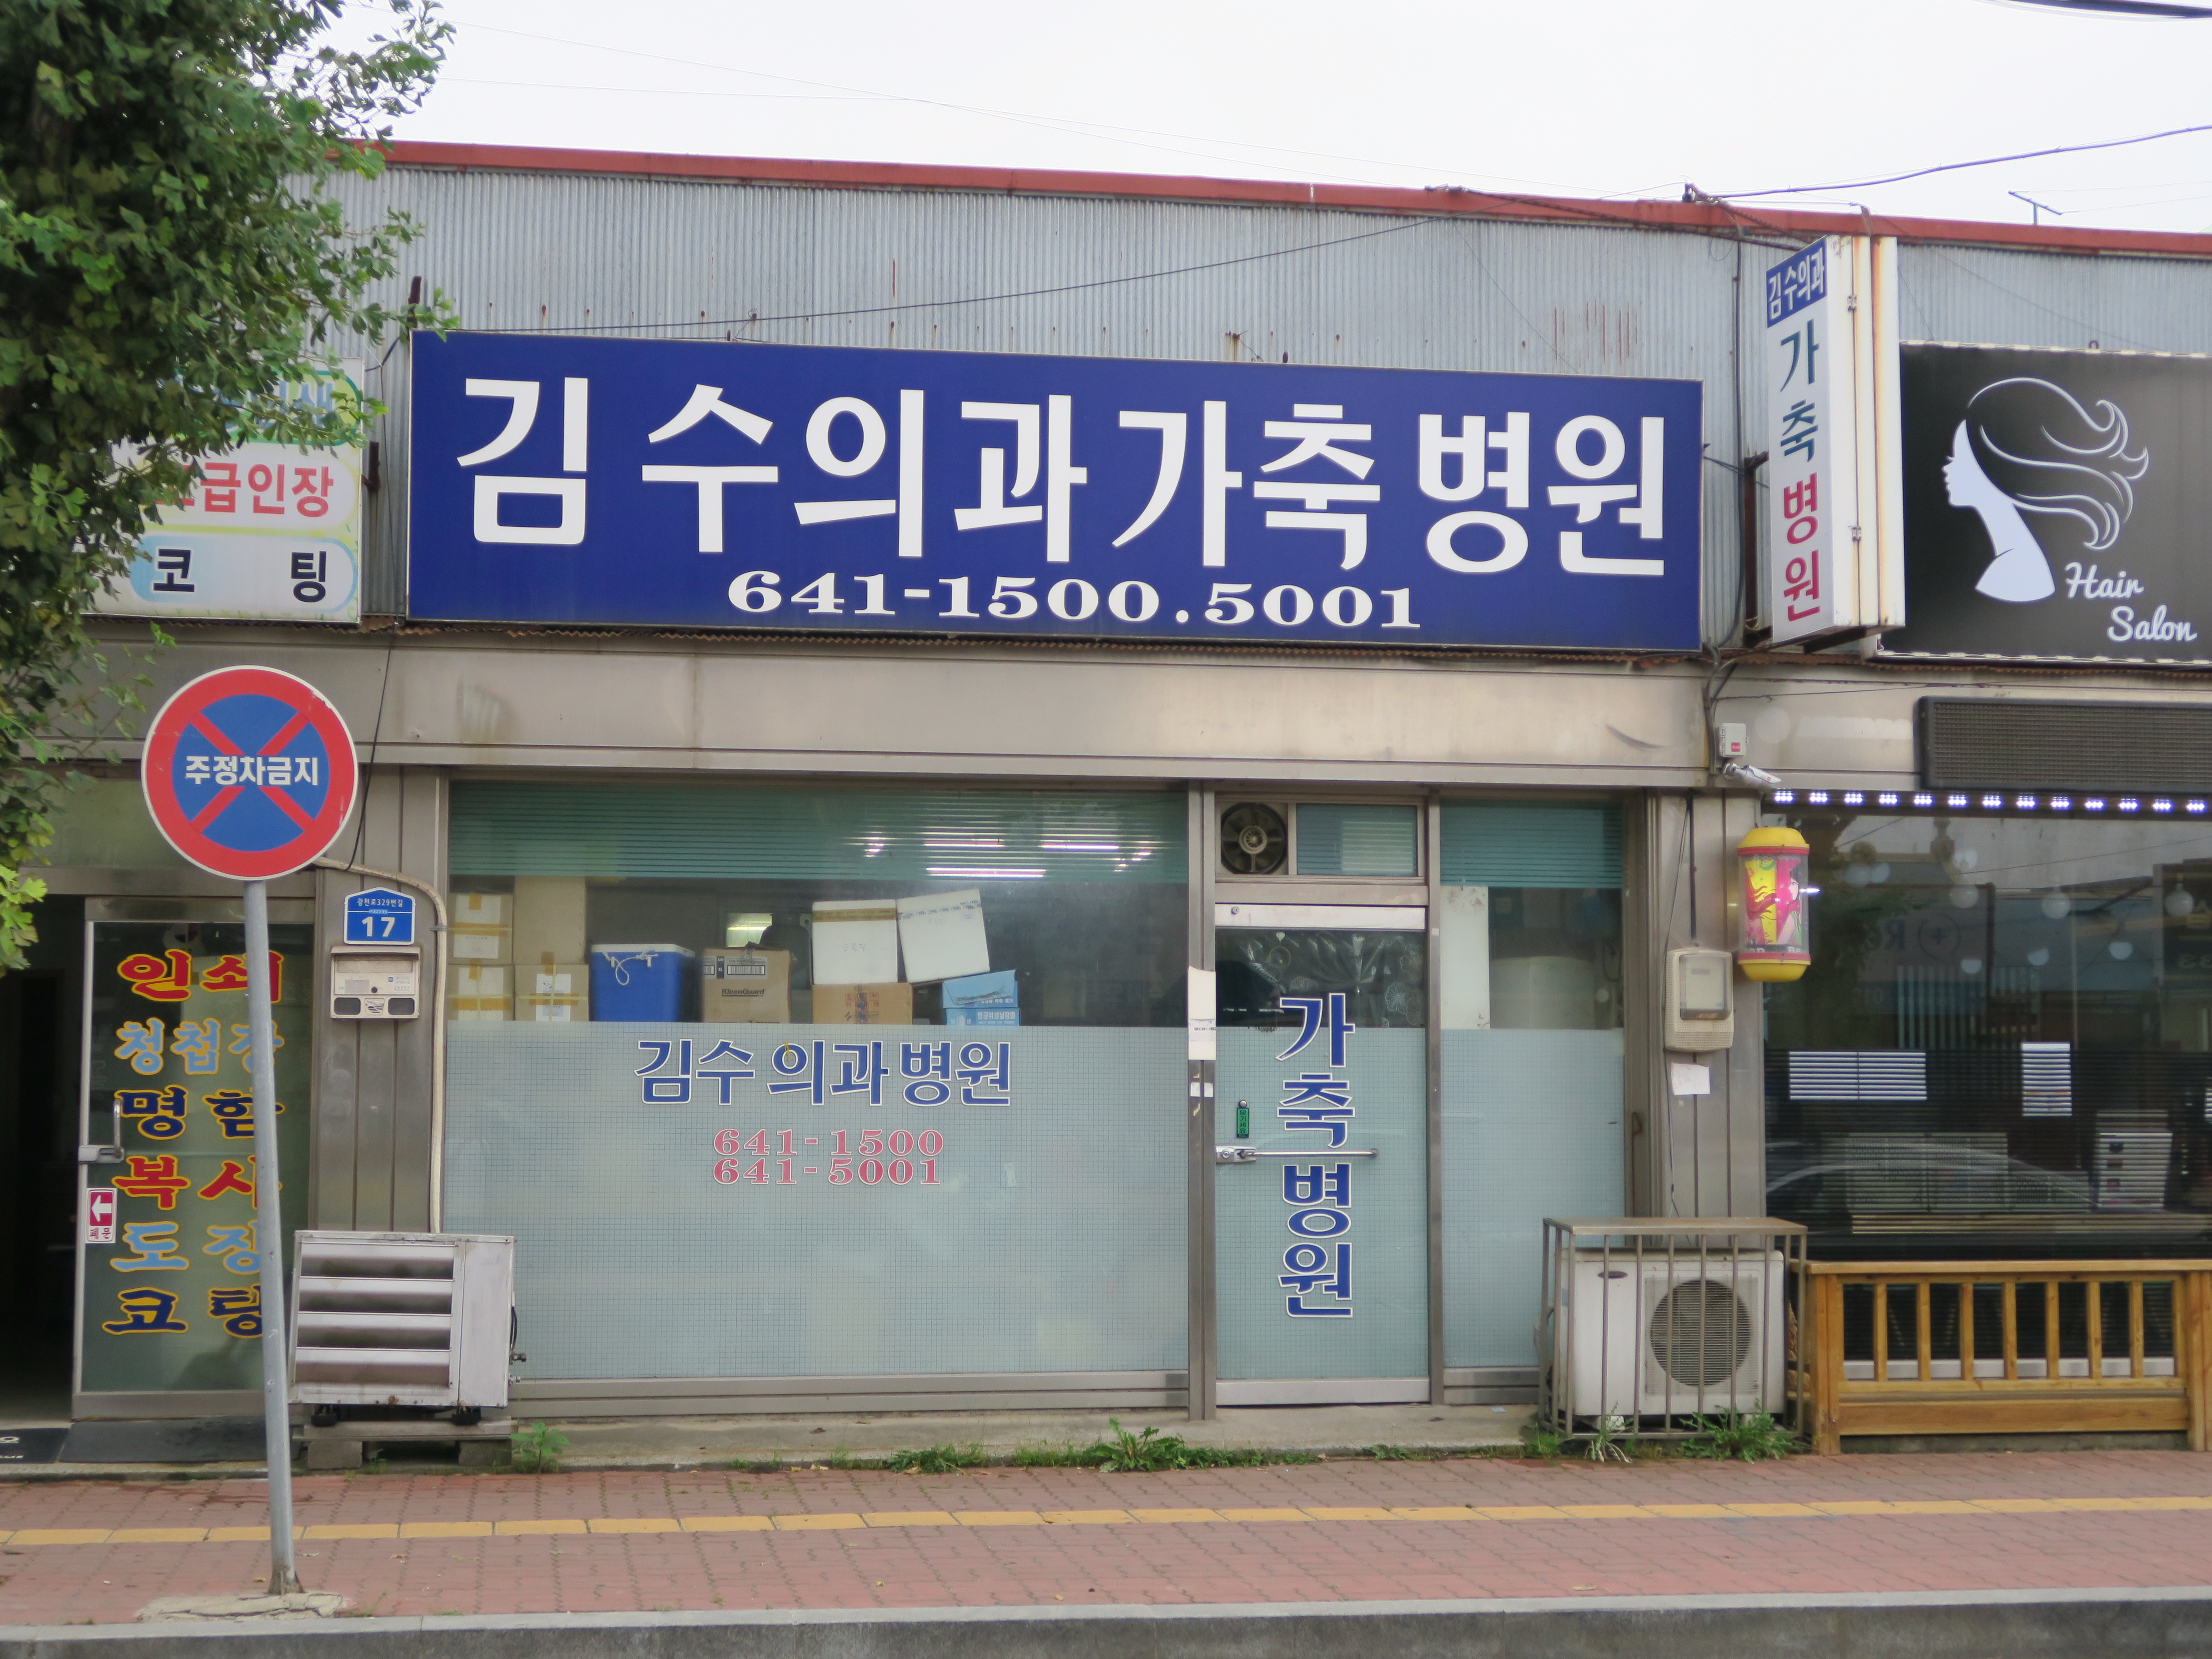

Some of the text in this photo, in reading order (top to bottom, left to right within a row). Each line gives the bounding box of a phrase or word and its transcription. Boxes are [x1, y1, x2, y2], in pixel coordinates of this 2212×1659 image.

[1768, 247, 1825, 319] 김수의과
[2065, 562, 2144, 599] Hair
[728, 570, 1421, 628] 641-1500.5001
[2107, 604, 2198, 642] Salon
[185, 755, 318, 786] 주정차금지
[362, 916, 395, 937] 17
[713, 1129, 944, 1156] 641-1500
[713, 1157, 941, 1185] 641-5001
